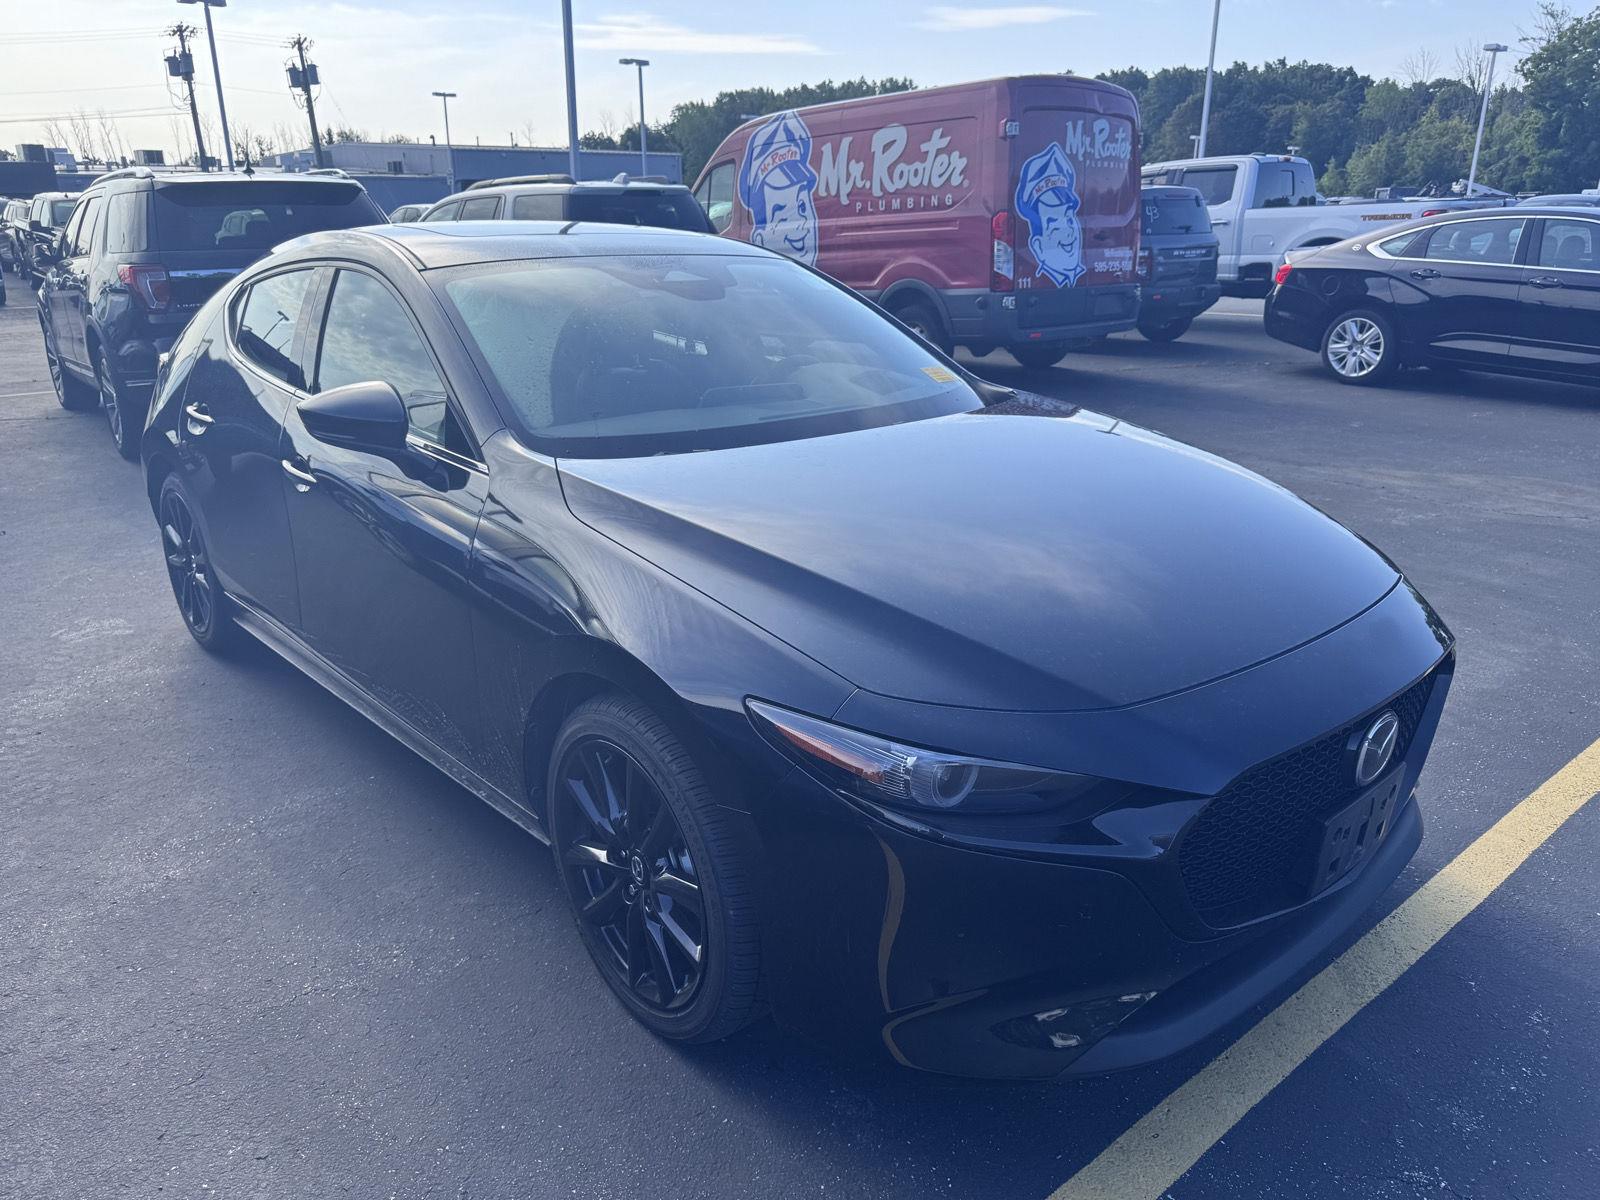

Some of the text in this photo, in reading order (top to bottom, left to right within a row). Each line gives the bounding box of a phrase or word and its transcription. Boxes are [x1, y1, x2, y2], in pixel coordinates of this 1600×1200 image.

[1093, 117, 1132, 159] Rooter
[818, 136, 871, 206] Mr.
[855, 194, 954, 213] PLUMBING
[1018, 277, 1031, 289] 111
